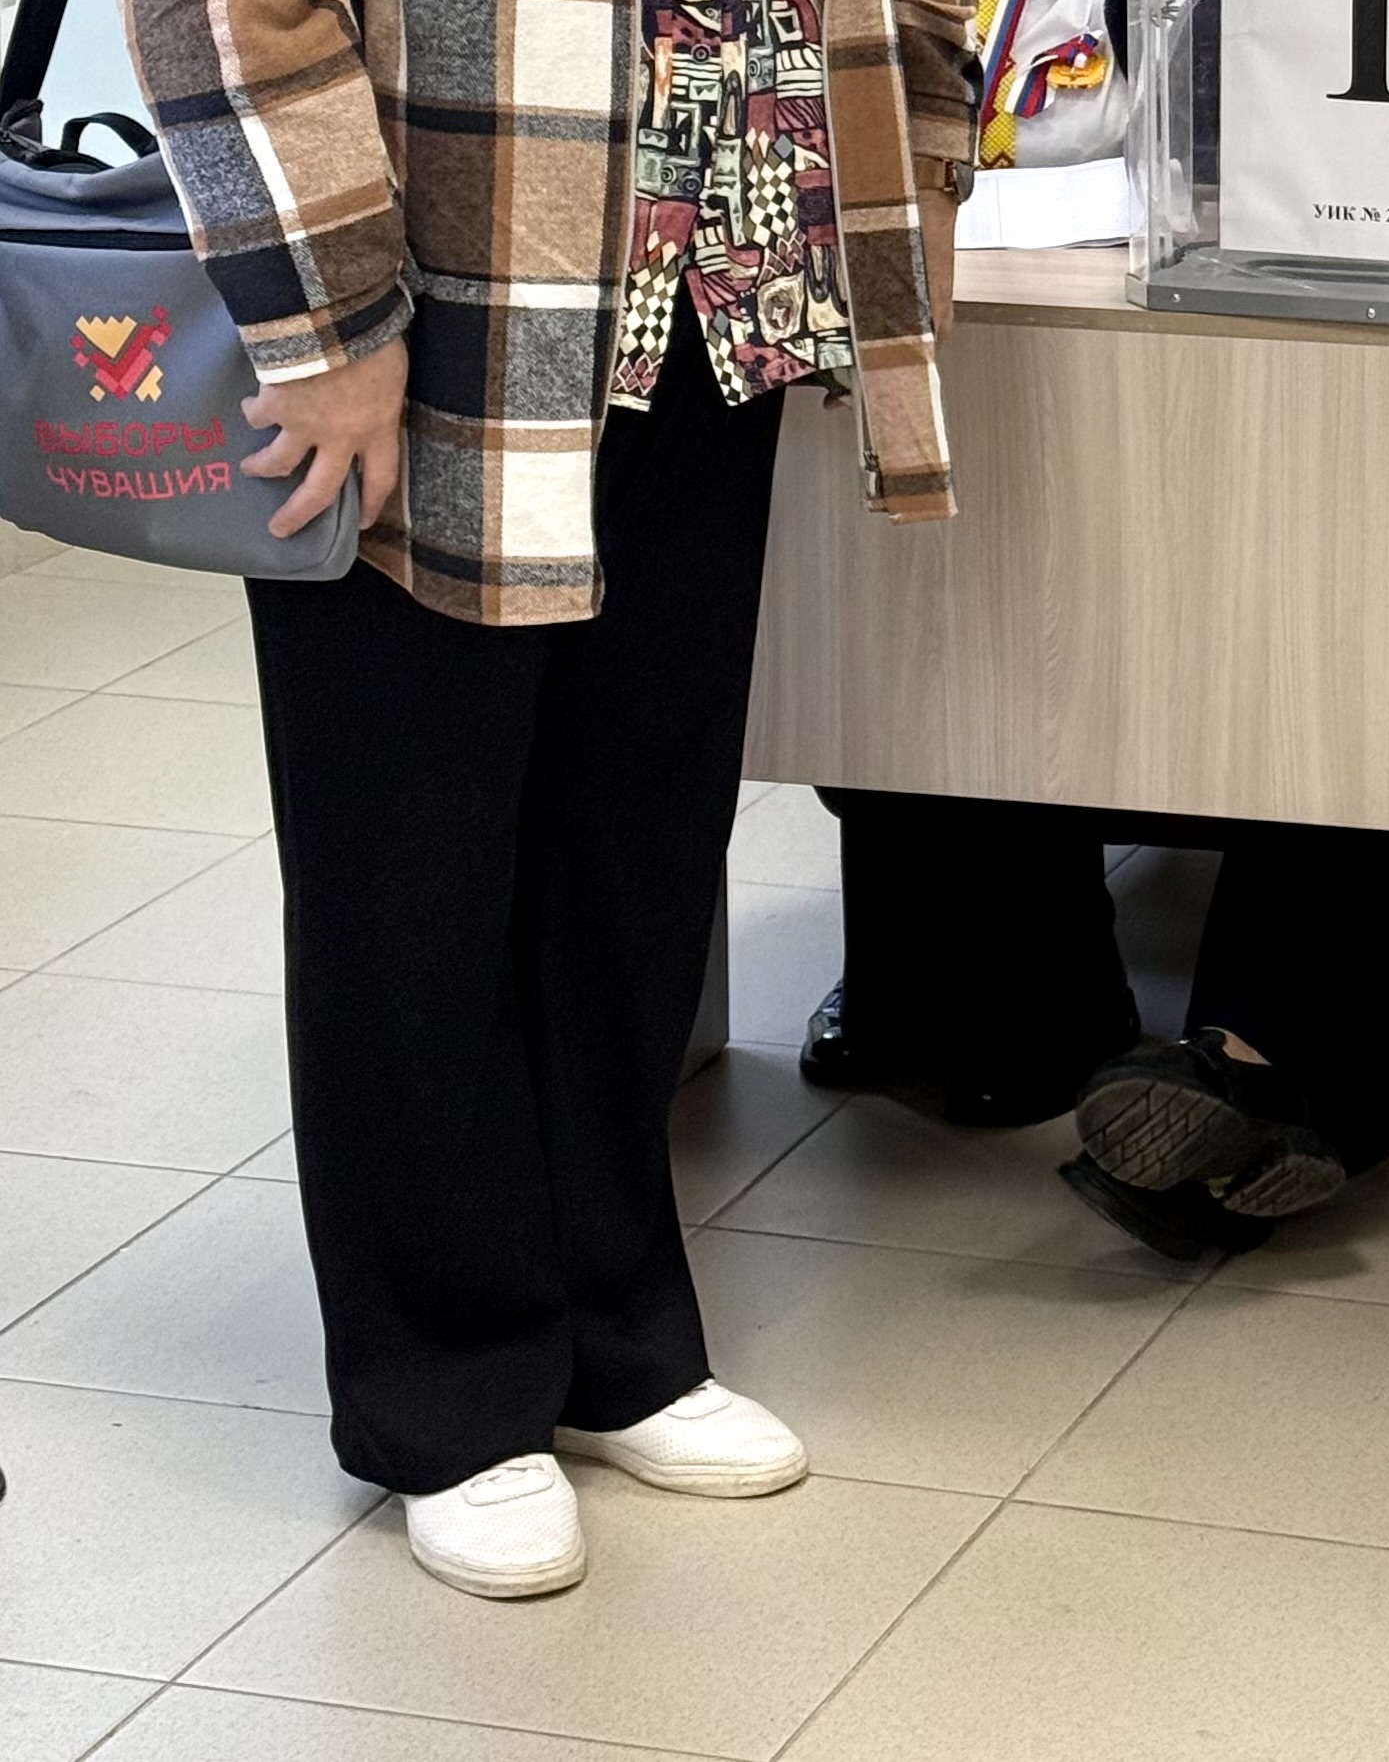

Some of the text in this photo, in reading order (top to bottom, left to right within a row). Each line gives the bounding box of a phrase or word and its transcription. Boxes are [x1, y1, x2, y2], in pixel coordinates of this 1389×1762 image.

[1312, 203, 1357, 222] УИК
[1359, 206, 1381, 223] №
[33, 416, 226, 458] ВЫБОРЫ
[45, 461, 231, 501] ЧУВАШИЯ
